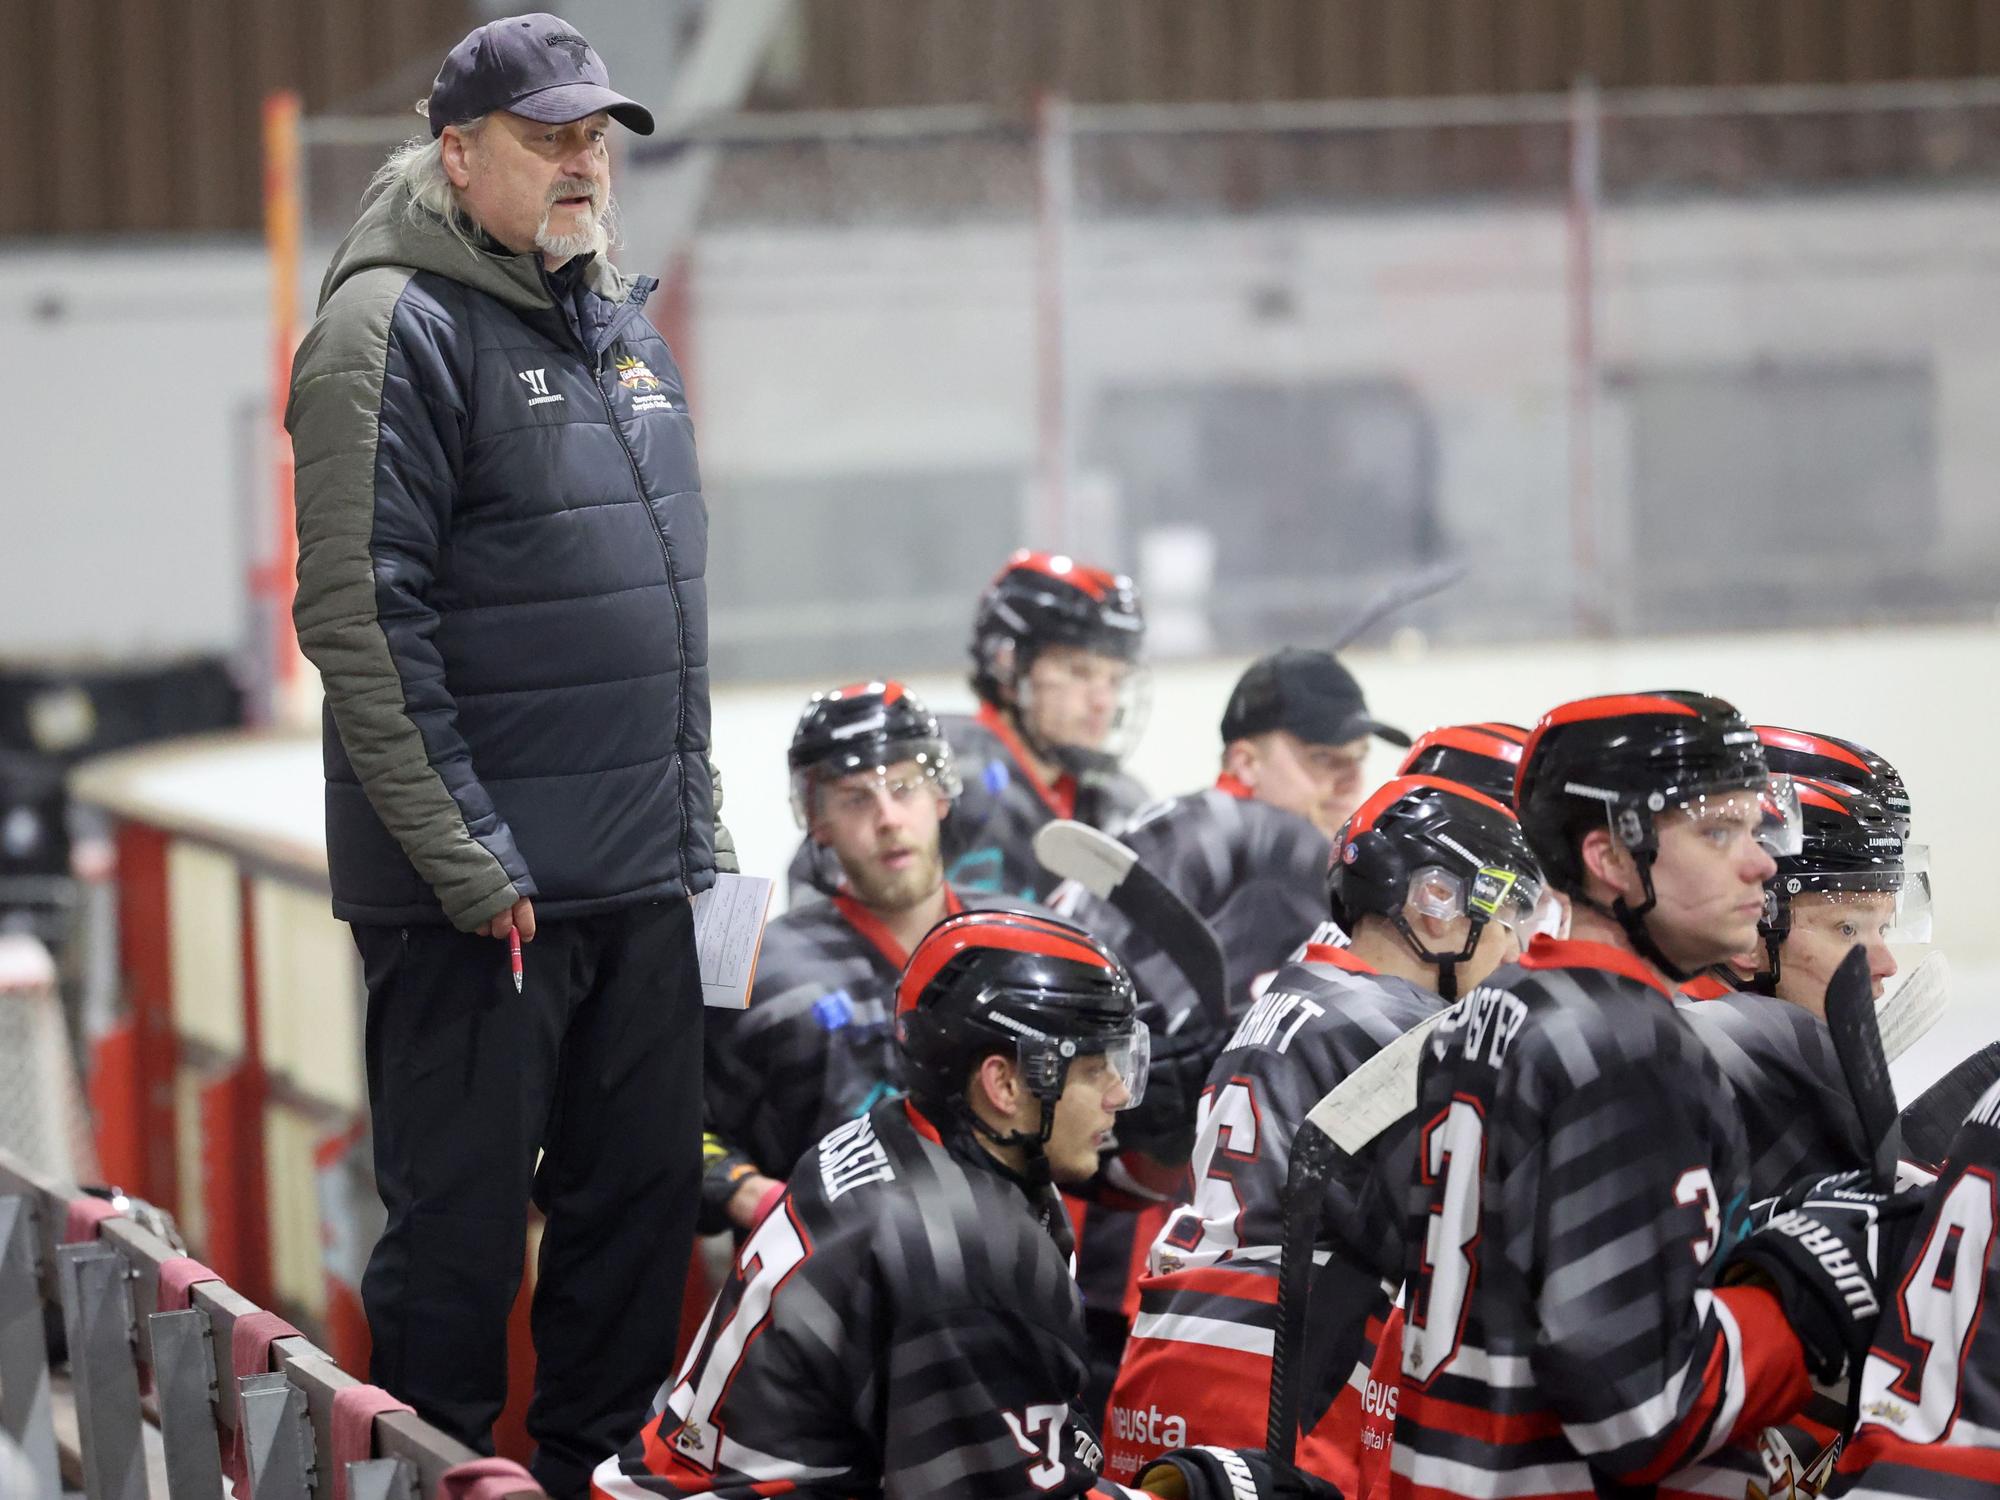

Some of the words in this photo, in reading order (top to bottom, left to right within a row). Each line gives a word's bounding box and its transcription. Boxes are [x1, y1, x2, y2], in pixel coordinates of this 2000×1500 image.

[1401, 1091, 1487, 1394] 3
[1672, 1167, 1722, 1267] 3
[1858, 1163, 2000, 1446] 9
